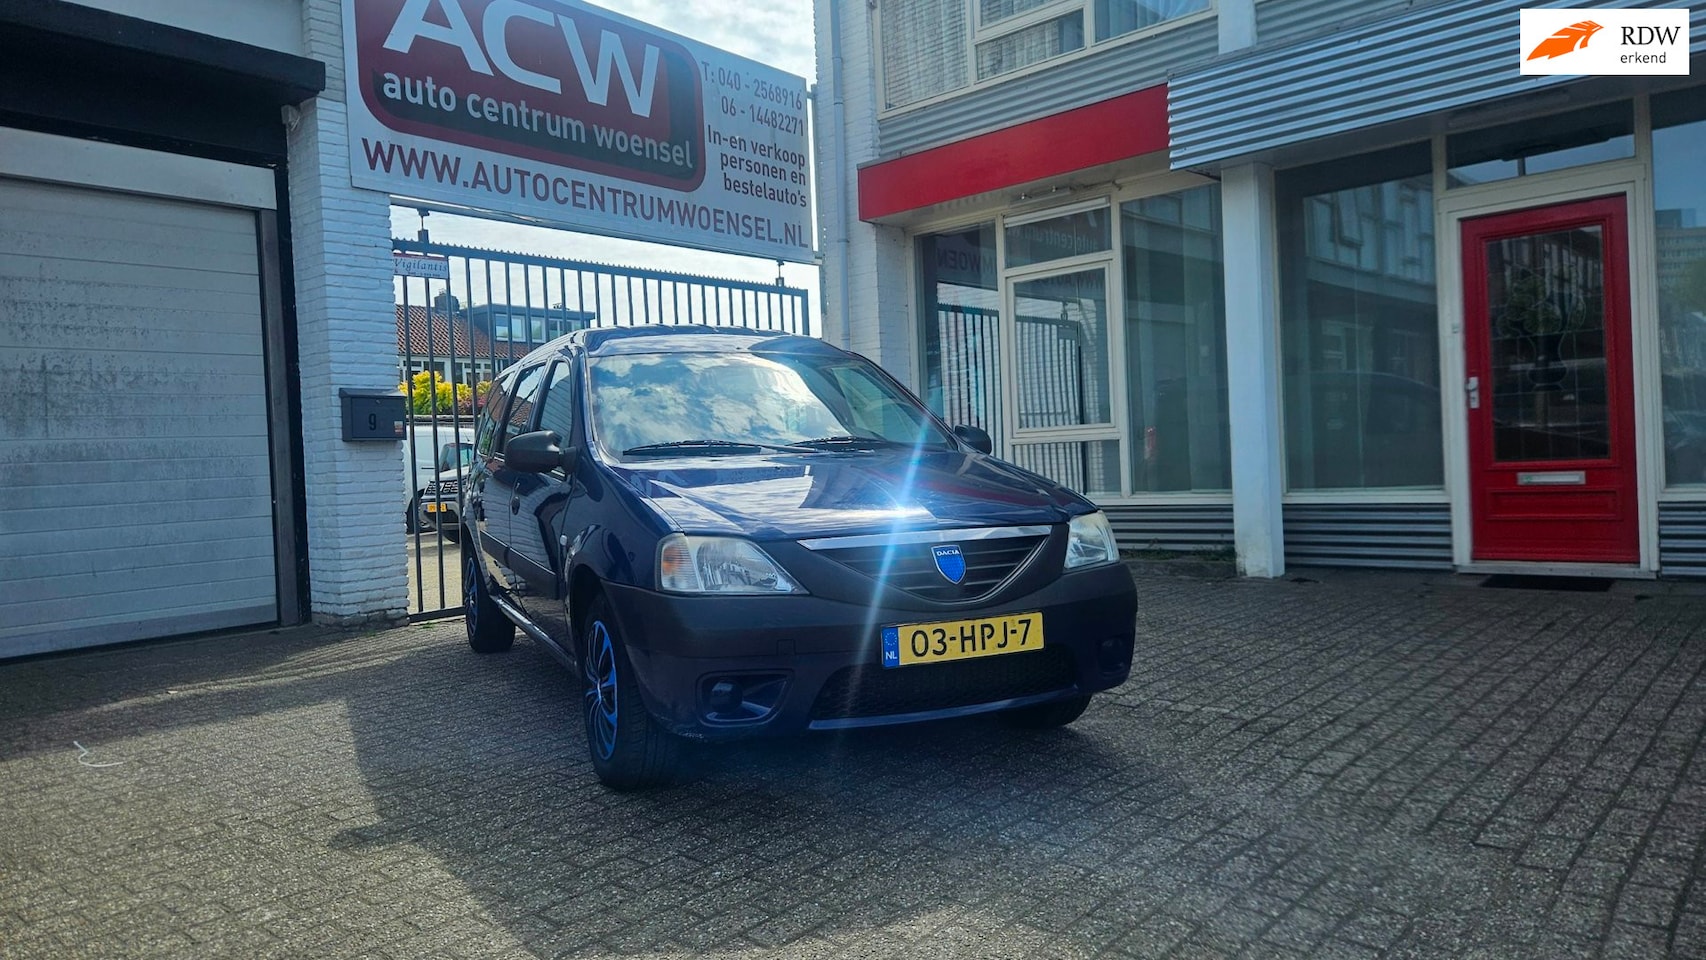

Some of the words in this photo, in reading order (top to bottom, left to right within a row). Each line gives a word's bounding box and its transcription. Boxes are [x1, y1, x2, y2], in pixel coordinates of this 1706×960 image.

[382, 0, 660, 118] ACW
[701, 61, 715, 83] T:
[718, 67, 741, 91] 040
[753, 78, 803, 111] 2568916
[383, 72, 457, 112] auto
[466, 93, 586, 144] centrum
[592, 124, 694, 169] woensel
[721, 95, 737, 117] 06
[749, 103, 804, 137] 14482271
[707, 124, 747, 150] In-en
[751, 140, 805, 171] verkoop
[720, 152, 787, 182] personen
[791, 170, 806, 187] en
[361, 137, 809, 249] WWW.AUTOCENTRUMWOENSEL.NL
[723, 172, 807, 208] bestelauto's
[394, 257, 448, 272] Vigilantis
[368, 413, 377, 432] 9
[936, 549, 961, 557] DACIA
[885, 651, 898, 660] NL
[910, 618, 1032, 658] 03-HPJ-7
